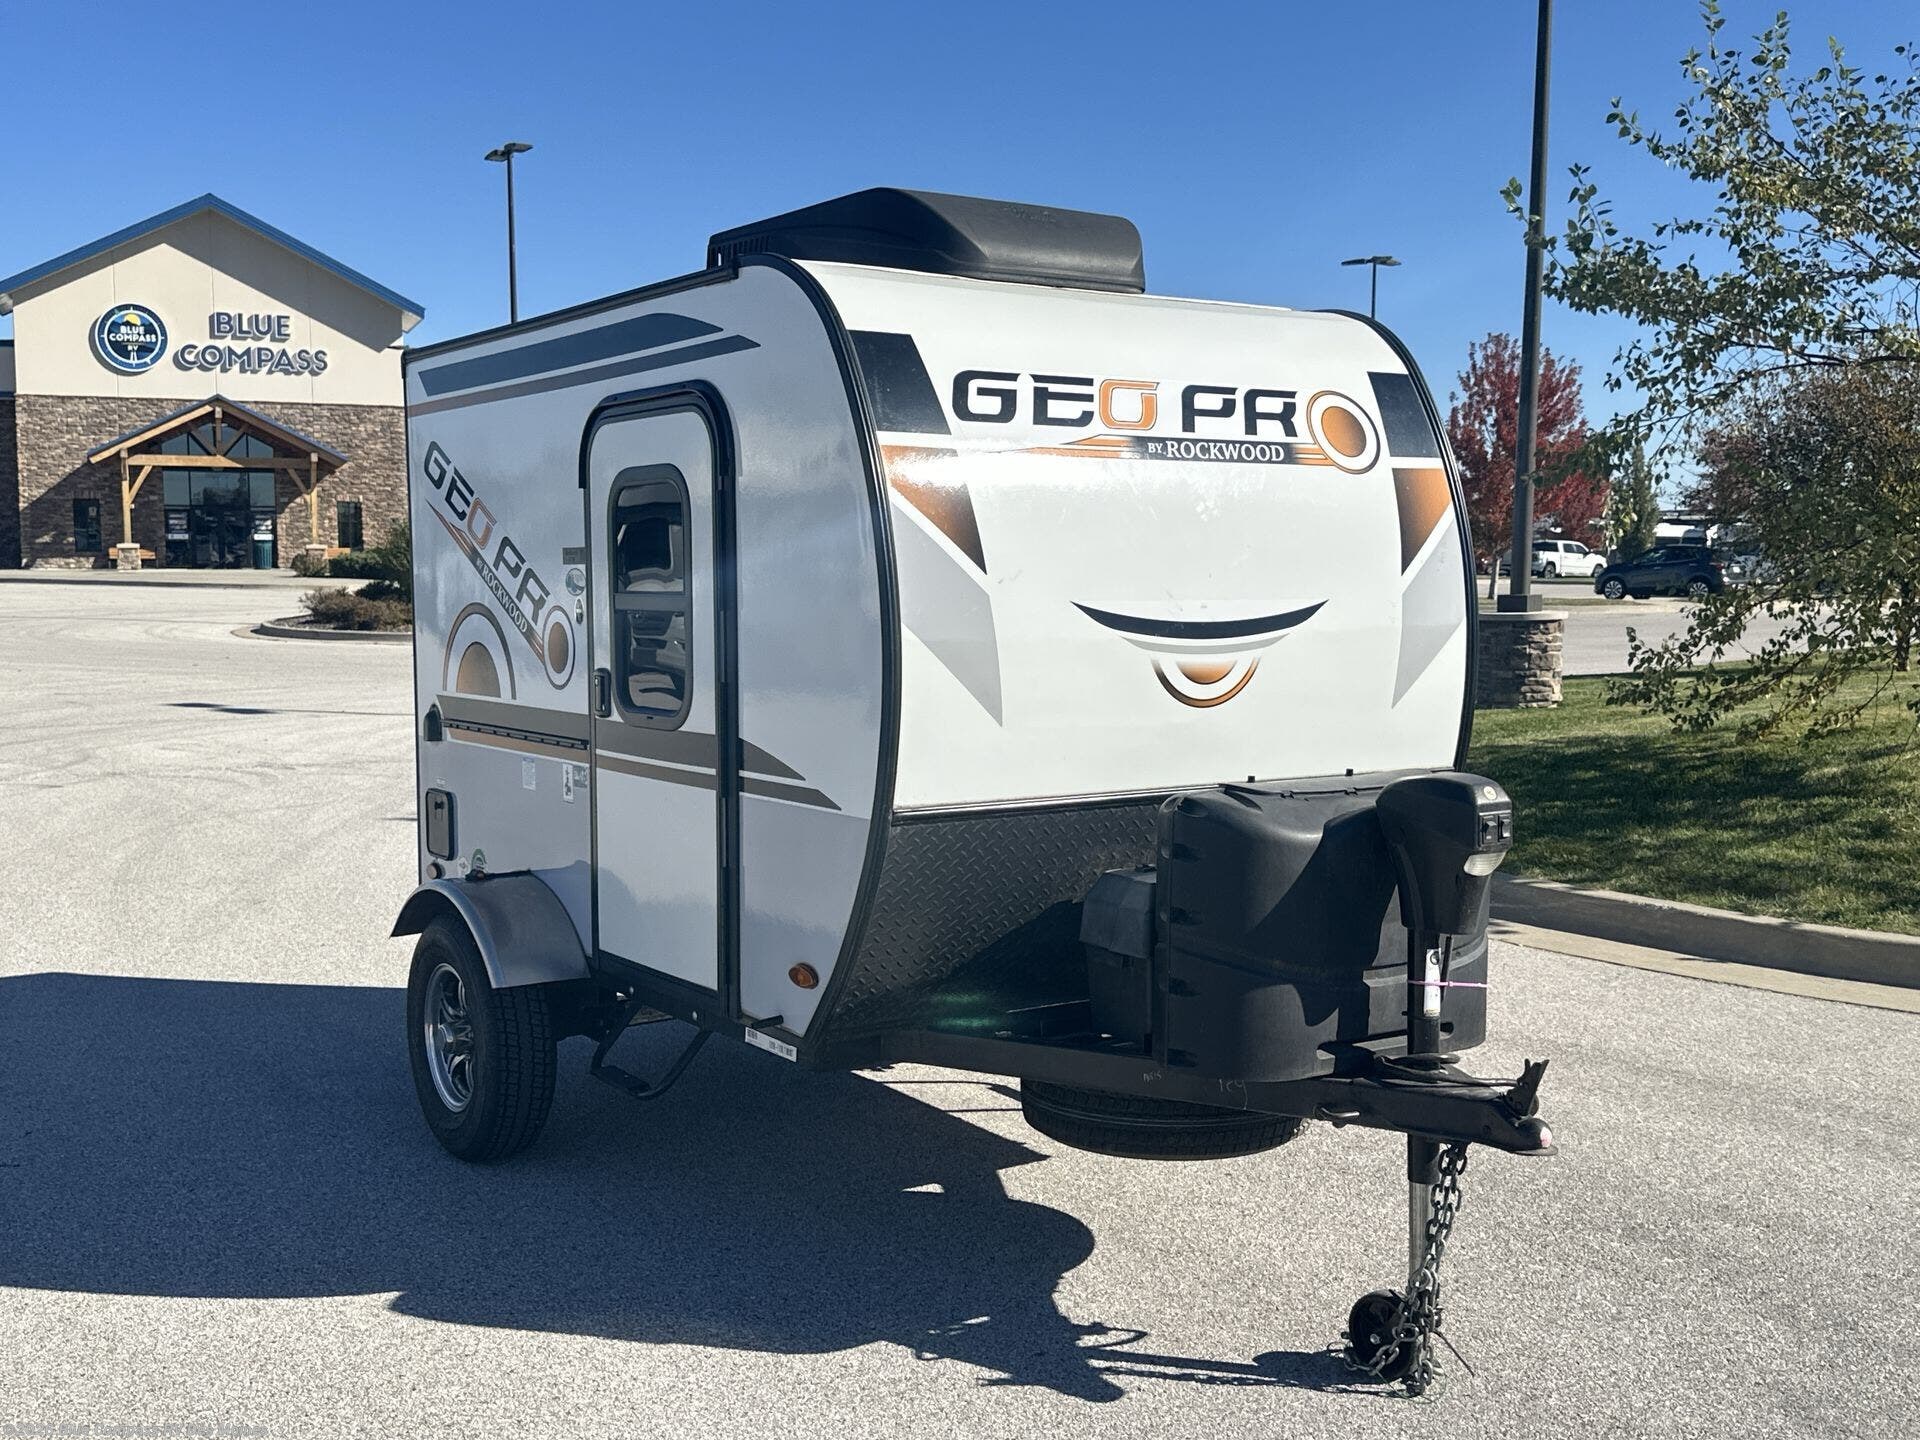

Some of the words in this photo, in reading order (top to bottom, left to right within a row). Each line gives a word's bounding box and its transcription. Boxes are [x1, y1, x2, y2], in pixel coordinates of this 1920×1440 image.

[109, 333, 157, 343] COMPASS
[120, 325, 145, 334] BLUE
[210, 312, 291, 342] BLUE
[174, 344, 328, 376] COMPASS
[952, 369, 1160, 431] GEO
[1166, 440, 1285, 462] ROCKWOOD
[481, 564, 528, 633] ROCKWOOD
